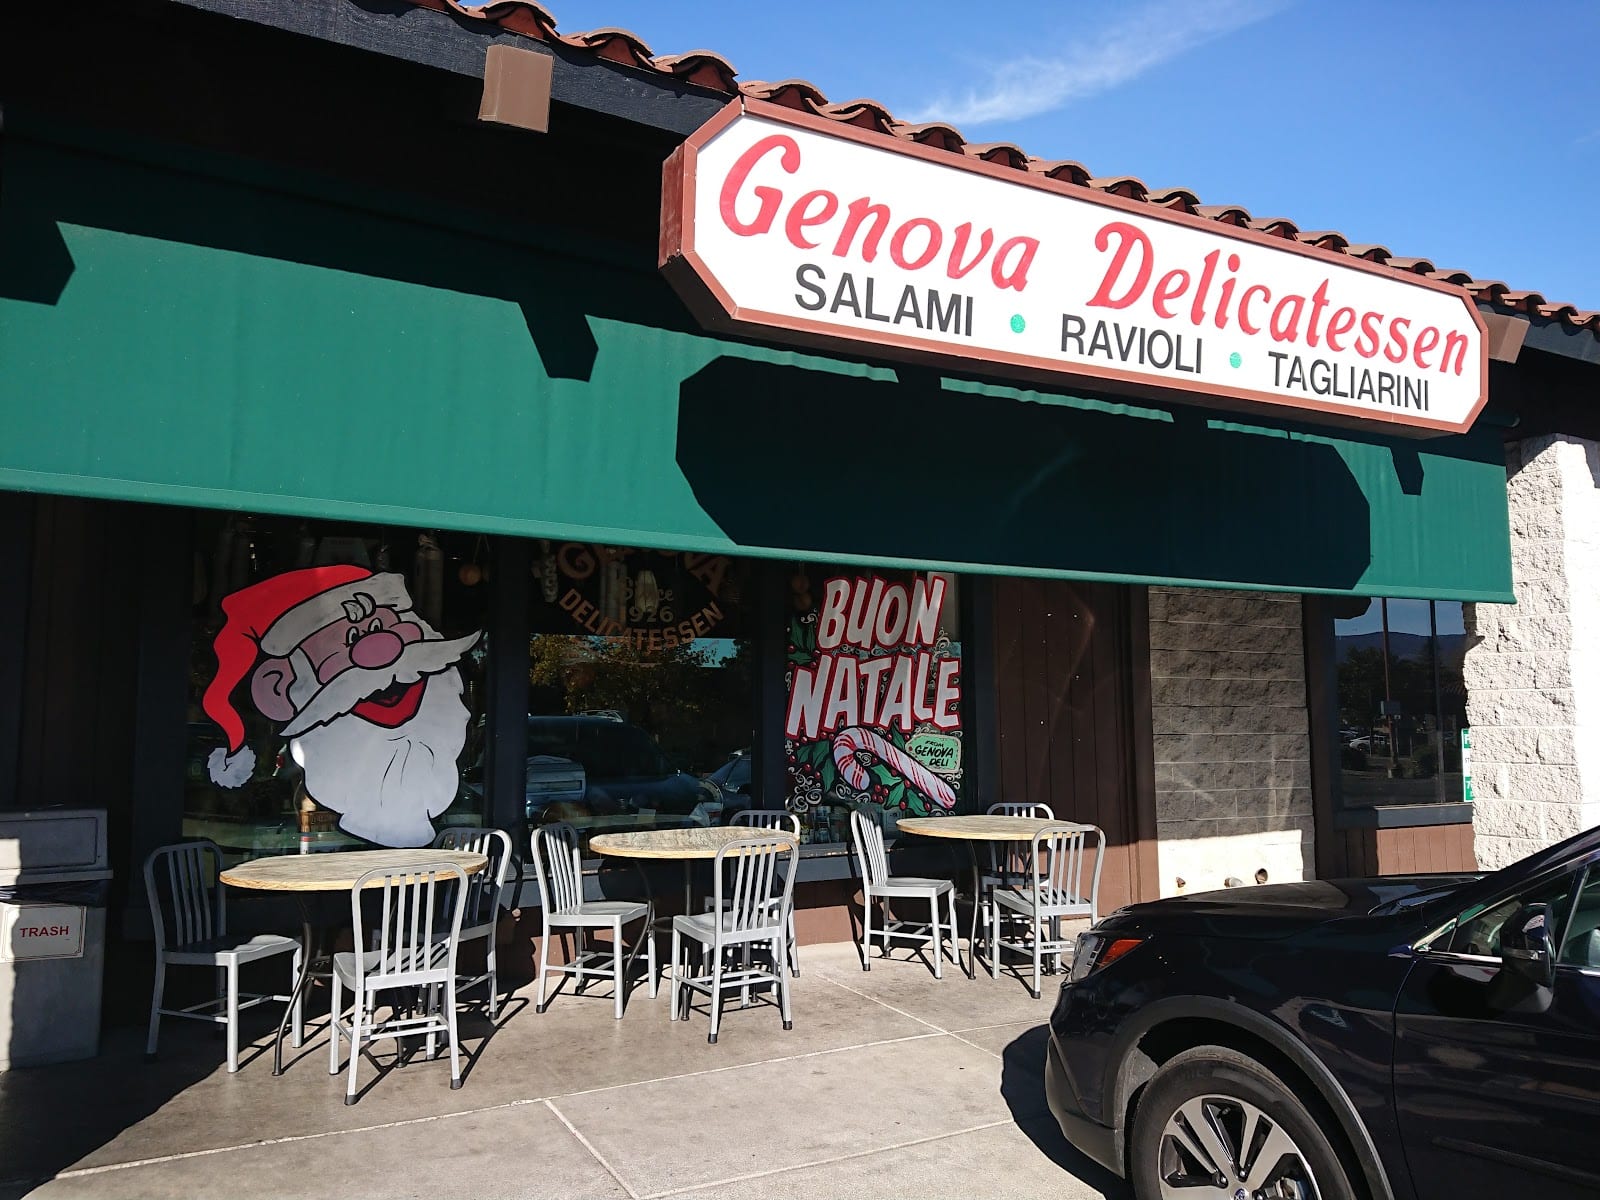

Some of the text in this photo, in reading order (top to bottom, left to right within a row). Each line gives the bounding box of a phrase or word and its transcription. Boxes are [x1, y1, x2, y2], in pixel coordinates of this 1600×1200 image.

[719, 134, 1469, 376] Genova Delicatessen
[795, 263, 1429, 411] SALAMI RAVIOLI TAGLIARINI
[817, 575, 948, 650] BUON
[785, 650, 962, 741] NATALE
[914, 745, 953, 758] GENOVA
[929, 758, 949, 766] DELI
[20, 925, 69, 937] TRASH
